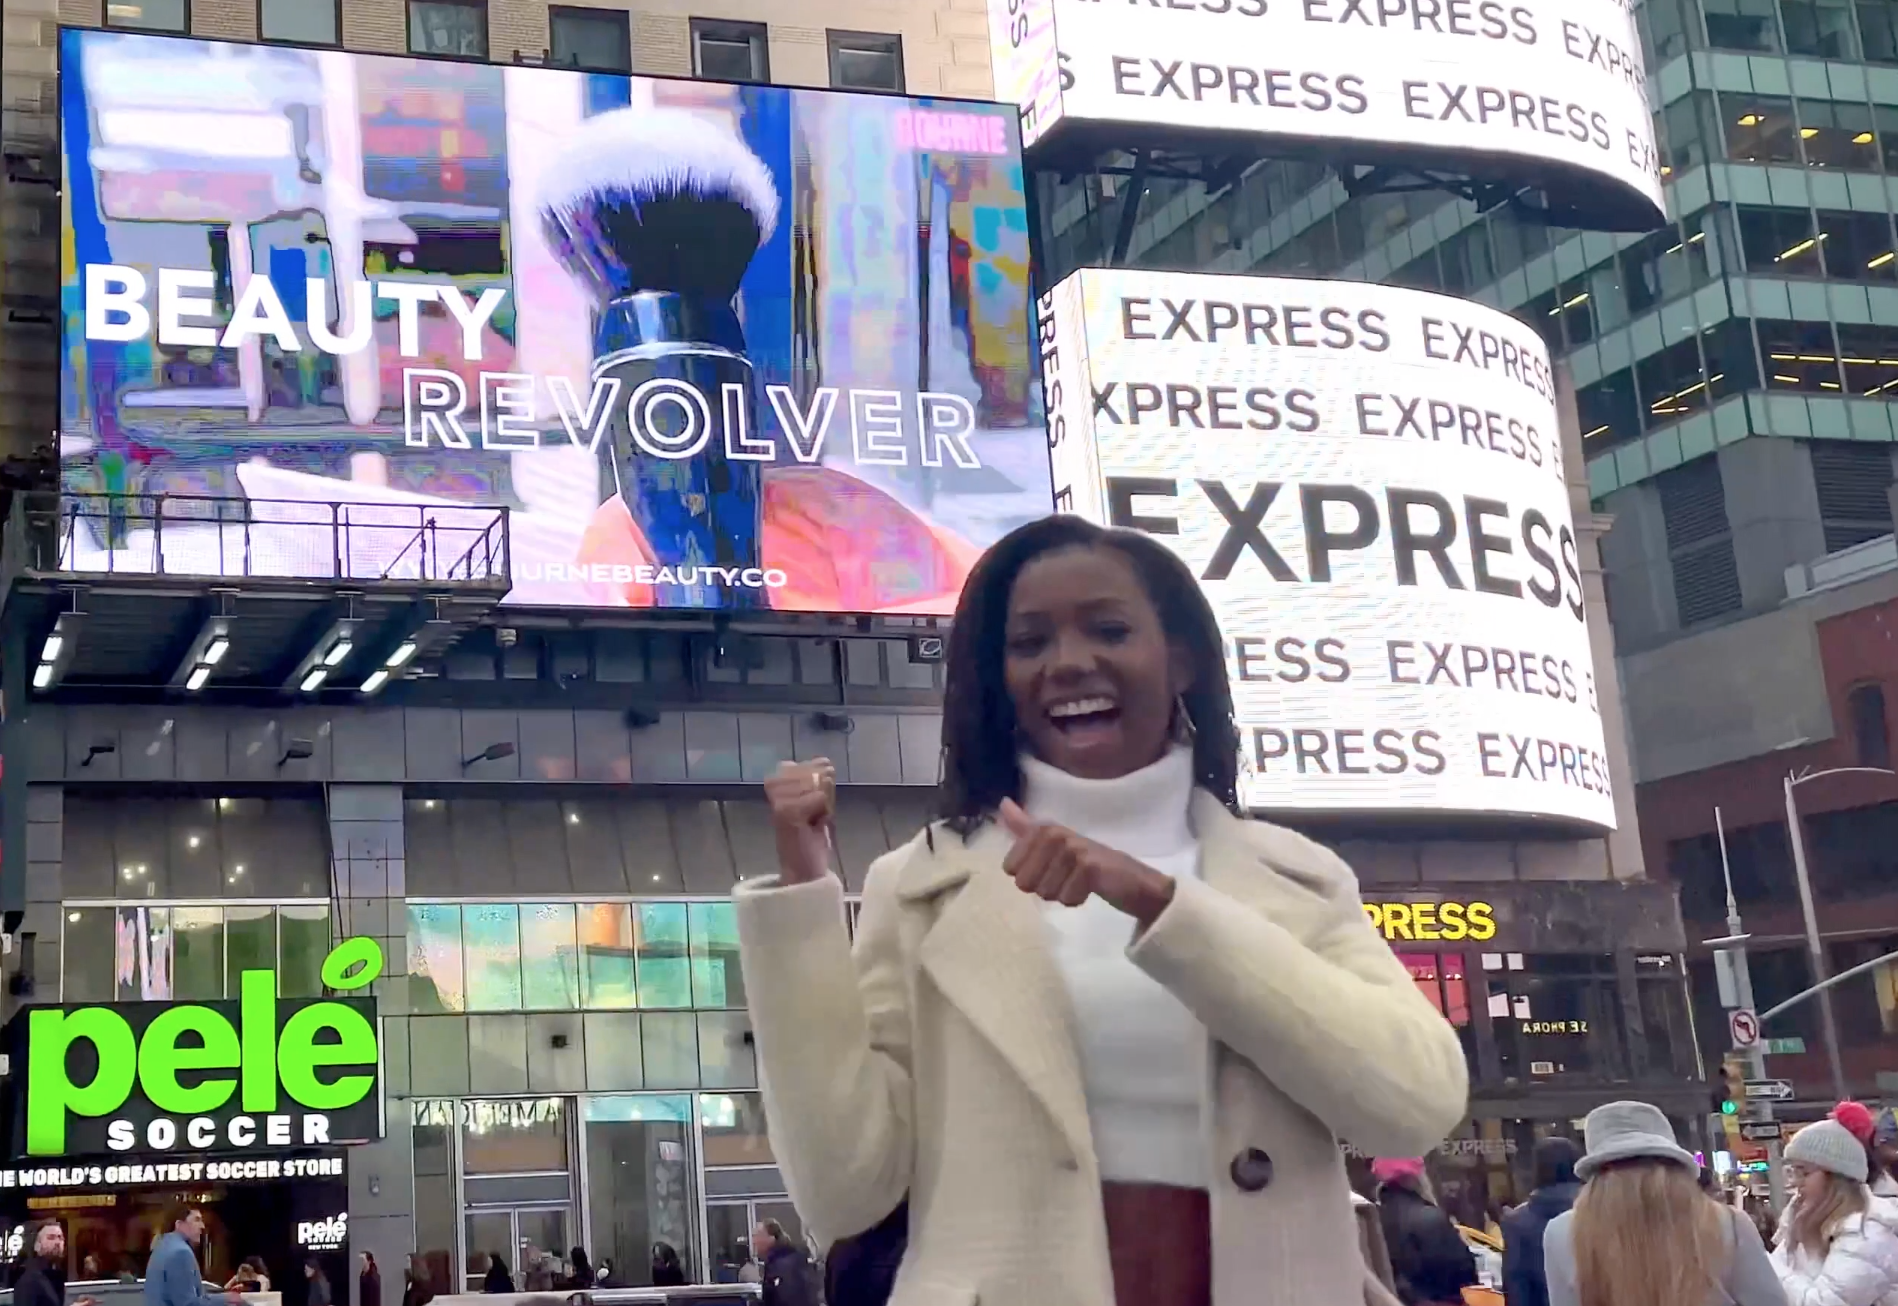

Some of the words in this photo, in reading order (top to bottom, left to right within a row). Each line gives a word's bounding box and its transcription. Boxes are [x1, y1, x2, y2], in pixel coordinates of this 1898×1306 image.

[1302, 0, 1537, 45] EXPRESS
[1112, 54, 1369, 114] EXPRESS
[1402, 79, 1610, 150] EXPRESS
[84, 263, 507, 360] BEAUTY
[1120, 296, 1391, 352] EXPRESS
[1421, 316, 1556, 406] EXPRESS
[402, 368, 981, 469] REVOLVER
[1091, 381, 1321, 432] XPRESS
[1356, 393, 1542, 467] EXPRESS
[1106, 475, 1585, 623] EXPRESS
[1386, 639, 1577, 704] EXPRESS
[1252, 726, 1447, 776] PRESS
[1477, 731, 1612, 799] EXPRESS
[18, 1166, 102, 1188] WORLD'S
[104, 1163, 204, 1184] GREATEST
[205, 1160, 281, 1180] SOCCER
[282, 1157, 343, 1177] STORE
[106, 1113, 331, 1151] SOCCER
